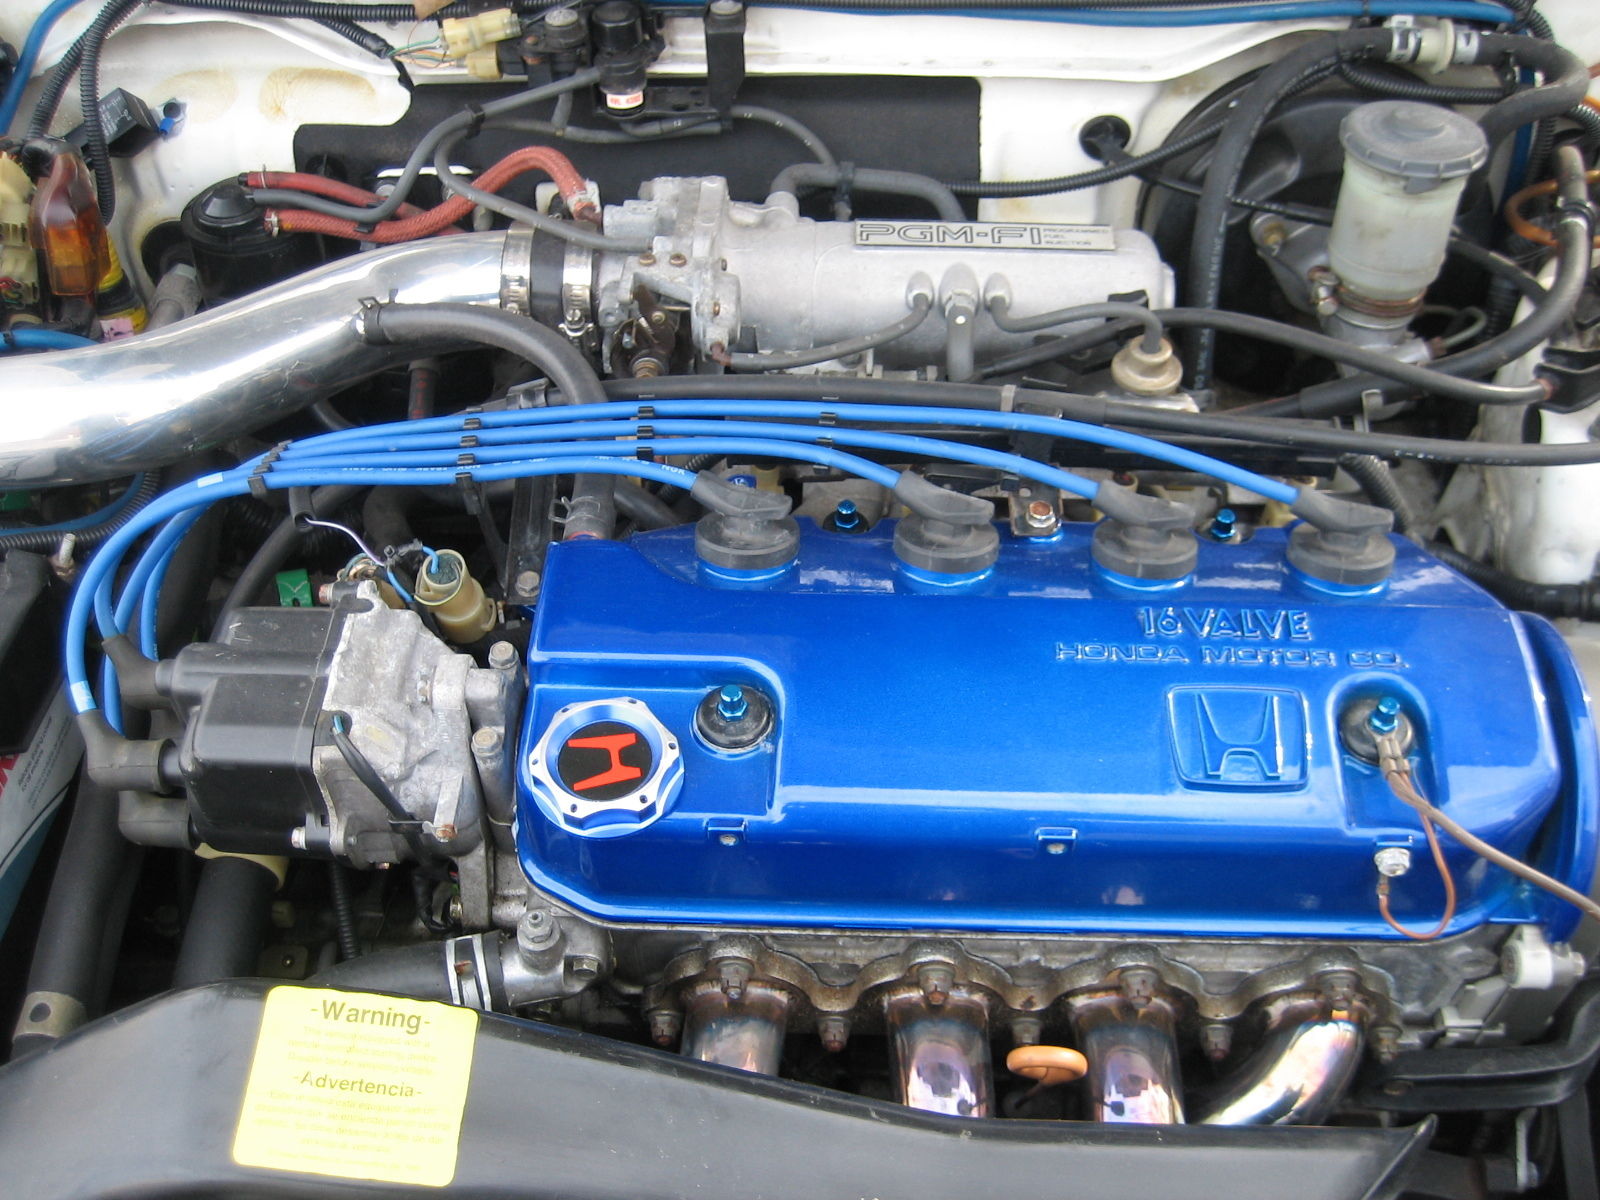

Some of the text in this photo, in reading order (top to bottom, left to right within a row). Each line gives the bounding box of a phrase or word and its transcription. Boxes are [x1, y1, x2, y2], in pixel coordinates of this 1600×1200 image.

[859, 224, 1042, 245] PGM-FI
[1139, 606, 1313, 641] 16 VALVE
[1055, 641, 1190, 664] HONDA
[1202, 645, 1337, 667] MOTOR
